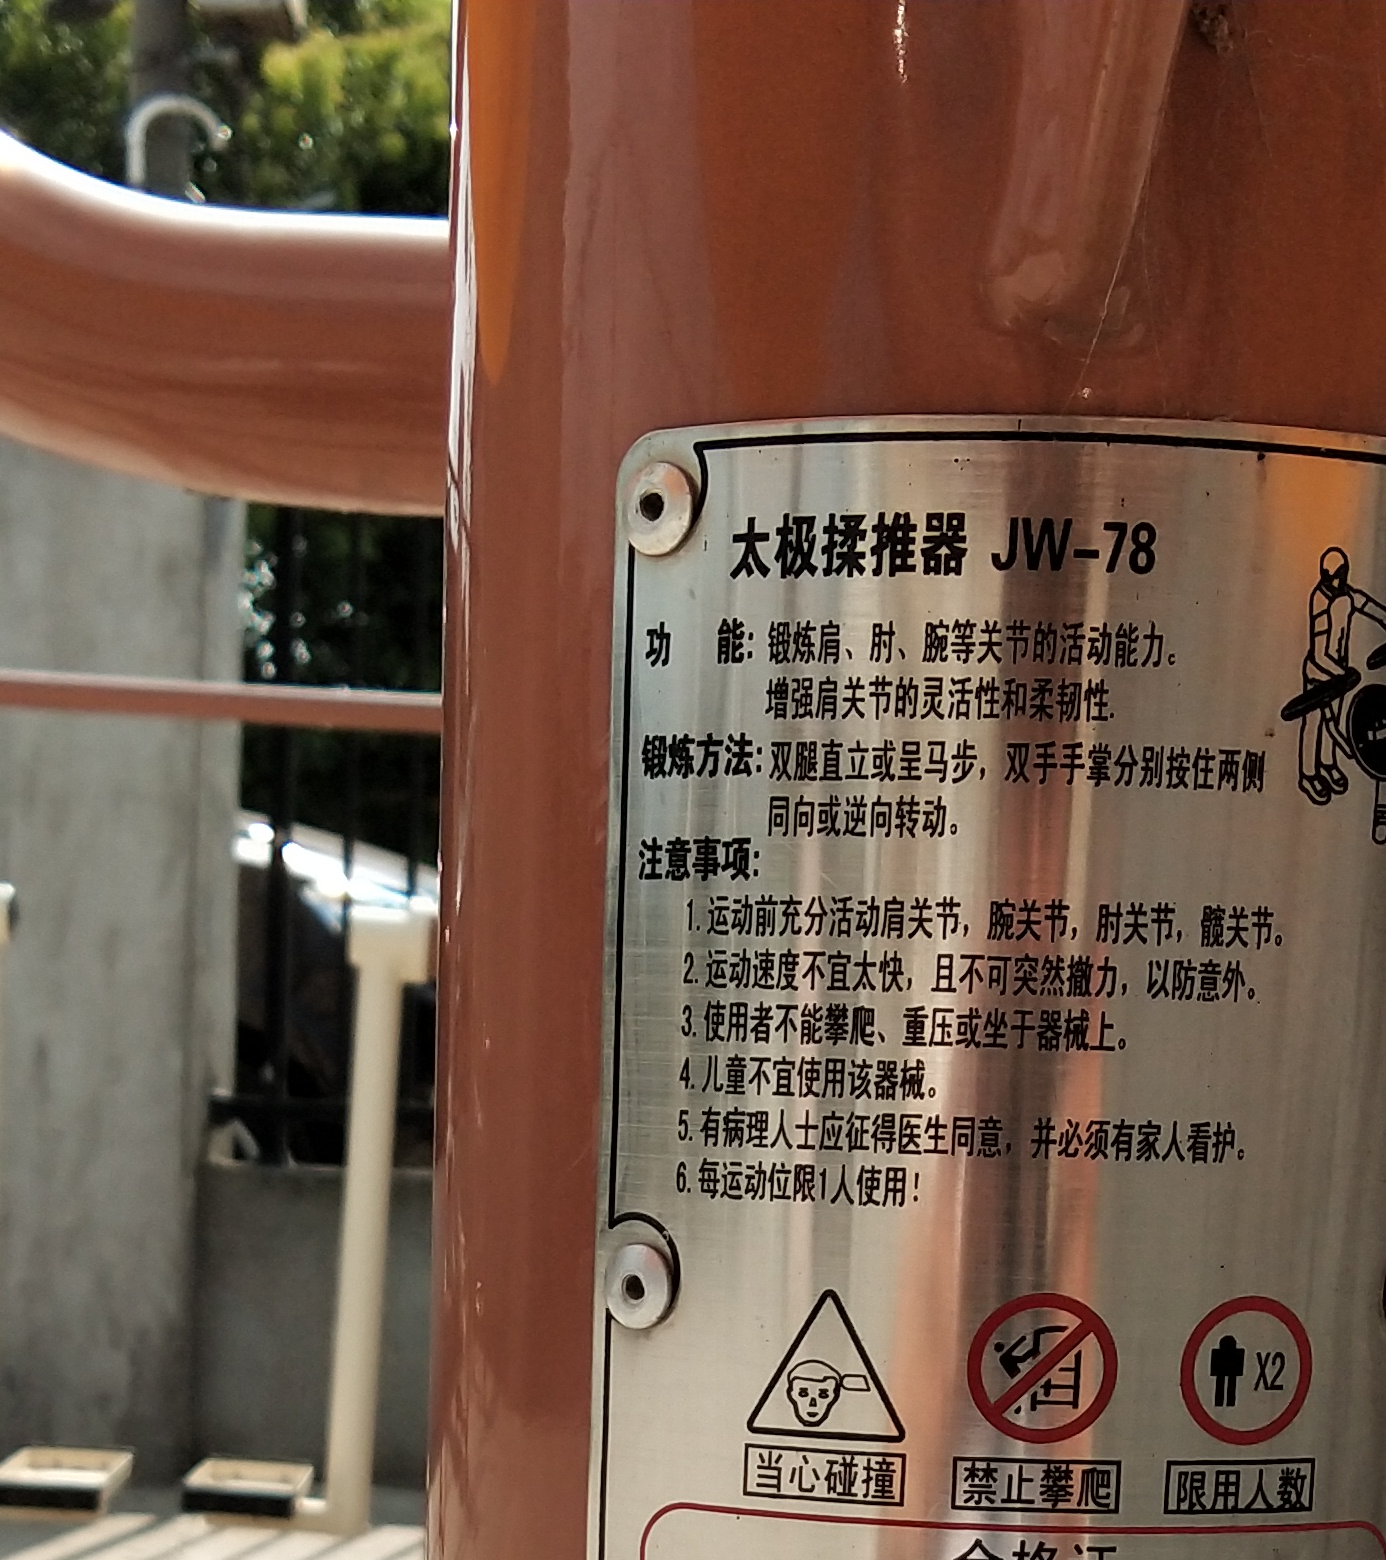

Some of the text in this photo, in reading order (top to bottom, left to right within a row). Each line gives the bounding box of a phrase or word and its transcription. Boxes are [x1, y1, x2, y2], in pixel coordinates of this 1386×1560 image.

[730, 511, 1158, 580] 太极揉推器 JW-78
[767, 794, 961, 839] 同向或逆向转动。
[637, 836, 761, 882] 注意事项：
[678, 1053, 937, 1101] 4.儿童不宜使用该器械。
[754, 1450, 897, 1502] 当心碰撞
[961, 1459, 1112, 1510] 禁止攀爬
[1175, 1465, 1308, 1510] 限用人数
